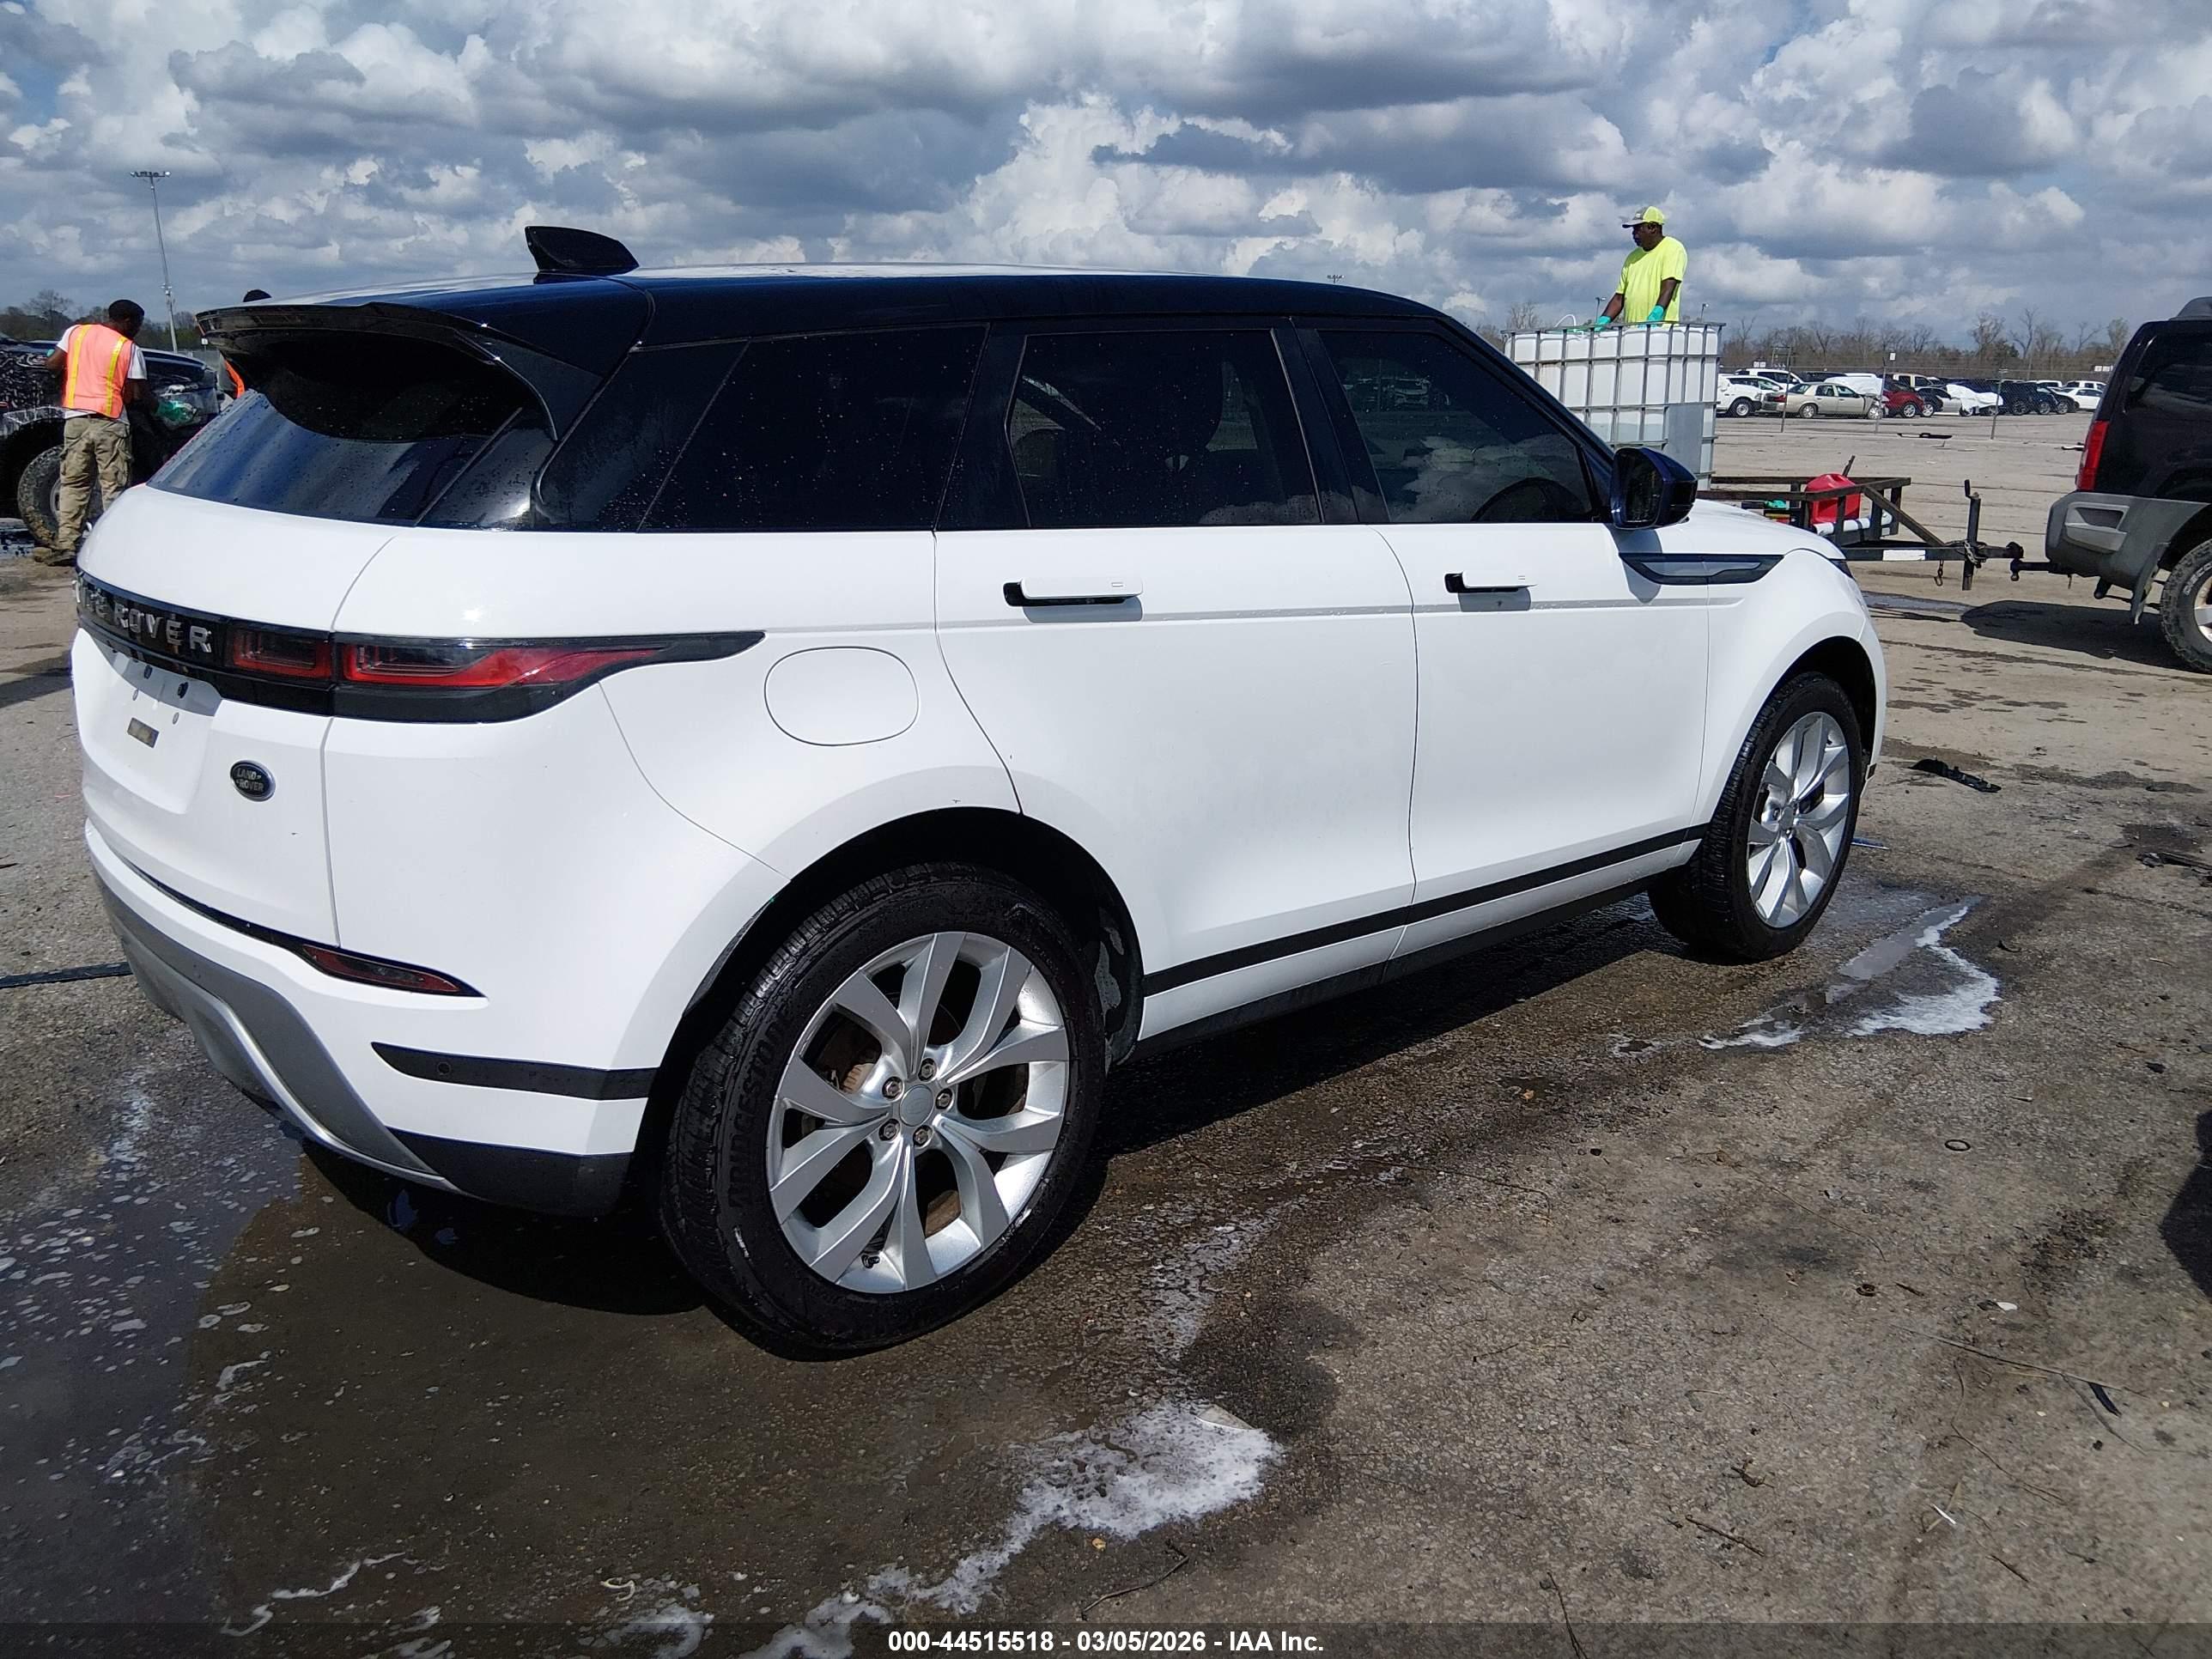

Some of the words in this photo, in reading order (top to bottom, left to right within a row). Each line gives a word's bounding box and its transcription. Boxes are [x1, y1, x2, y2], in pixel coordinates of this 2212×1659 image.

[113, 601, 212, 653] ROVER
[236, 768, 257, 781] LAND
[239, 780, 264, 793] ROVER
